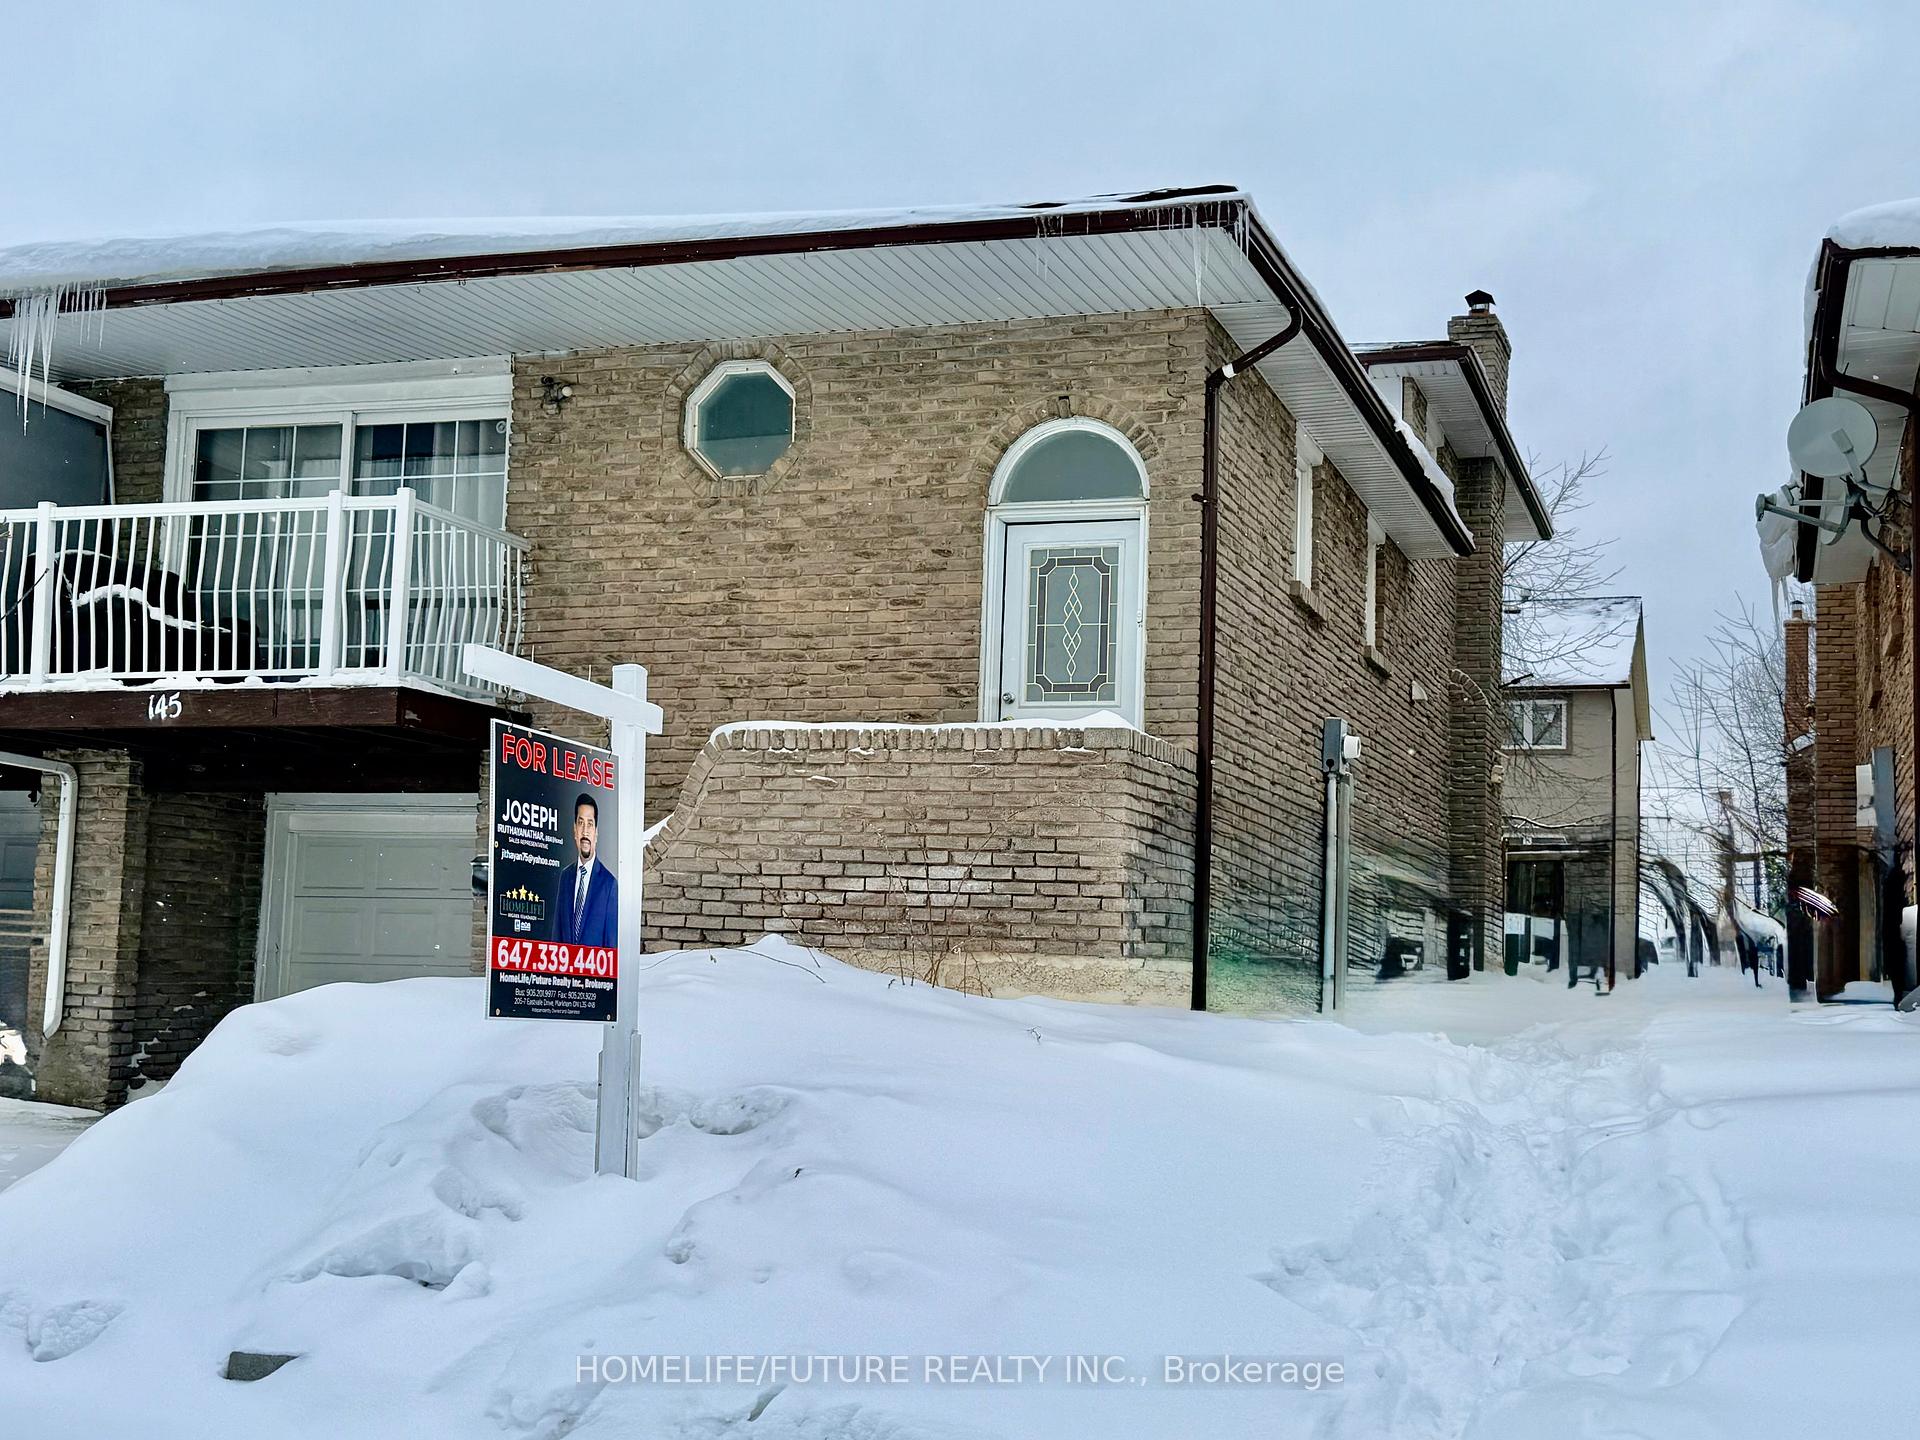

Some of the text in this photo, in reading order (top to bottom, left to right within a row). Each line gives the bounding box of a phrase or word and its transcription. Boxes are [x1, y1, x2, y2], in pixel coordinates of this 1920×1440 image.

[148, 691, 182, 720] 145
[502, 733, 615, 791] FOR LEASE
[501, 798, 559, 832] JOSEPH
[502, 898, 543, 915] HOMELIFE
[497, 939, 614, 977] 647.339.4401
[499, 971, 552, 986] HomeLife/Future
[552, 975, 571, 989] Realty
[584, 978, 614, 991] Brokerage
